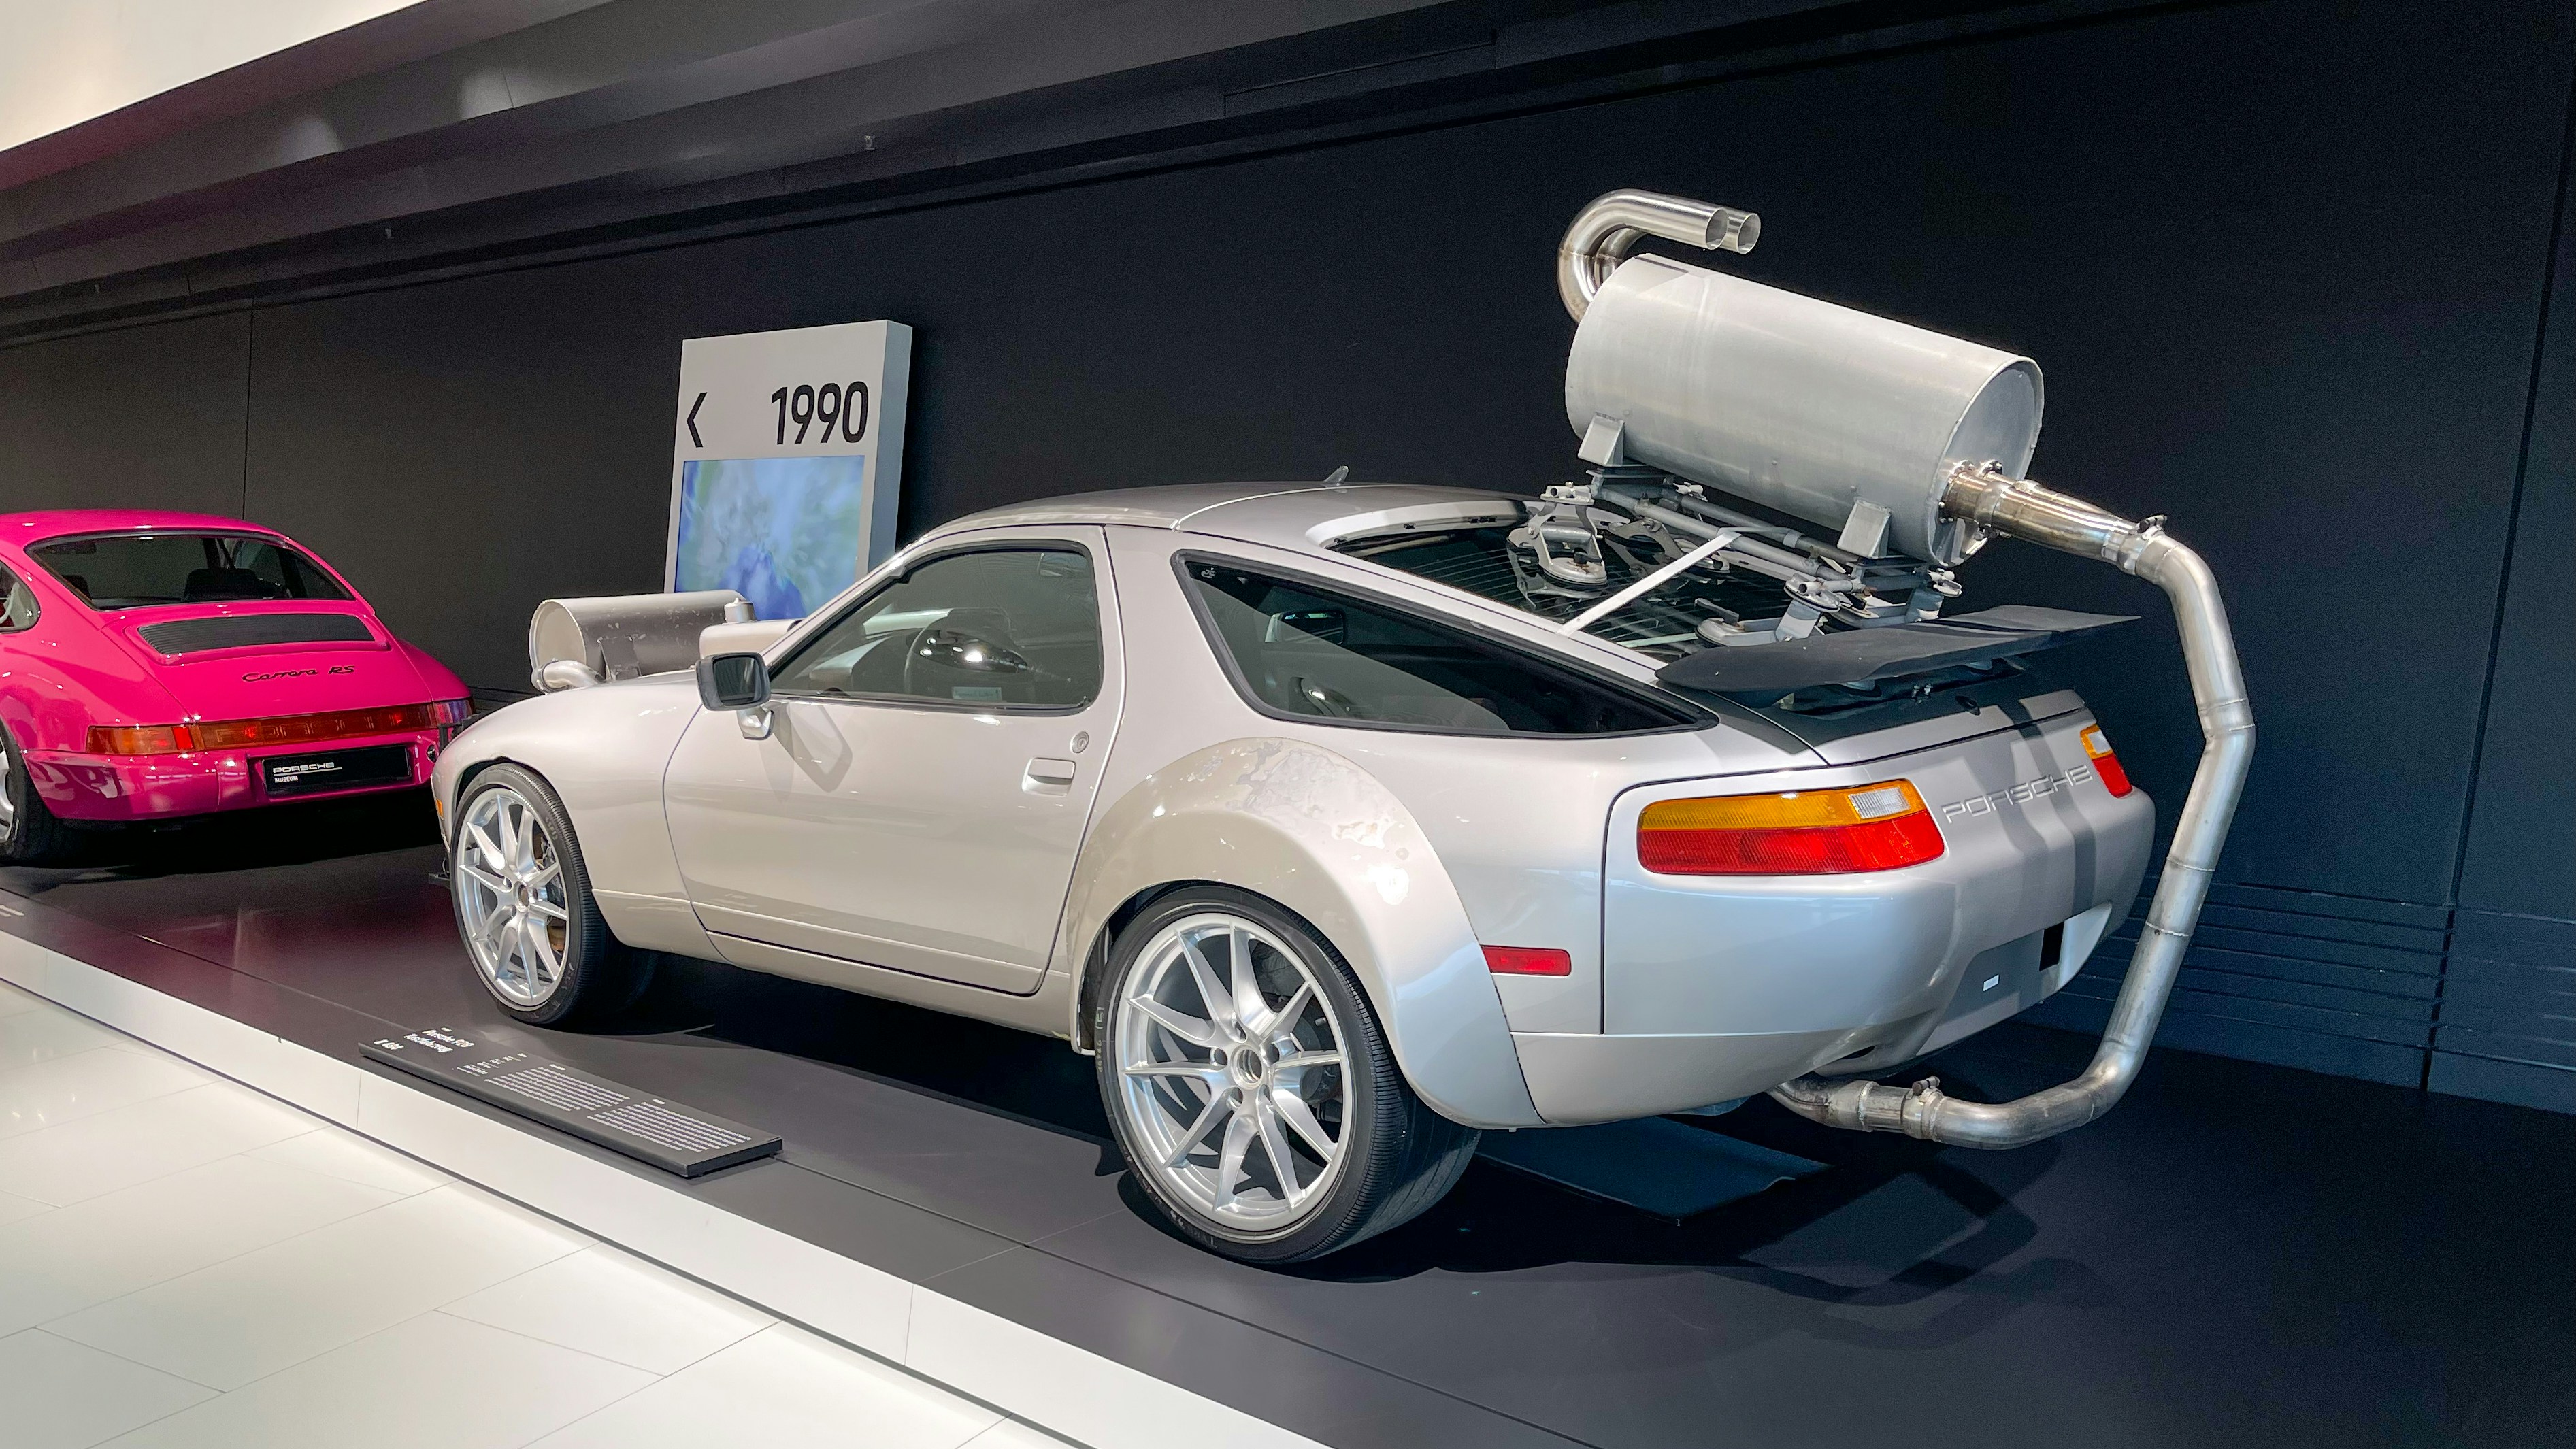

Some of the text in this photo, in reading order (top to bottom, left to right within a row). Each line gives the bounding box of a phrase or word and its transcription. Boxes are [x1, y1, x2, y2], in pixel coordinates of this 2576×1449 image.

[771, 380, 869, 445] 1990
[242, 665, 355, 682] Carrera RS
[273, 761, 335, 773] PORSCHE
[1941, 764, 2093, 824] PORSCHE
